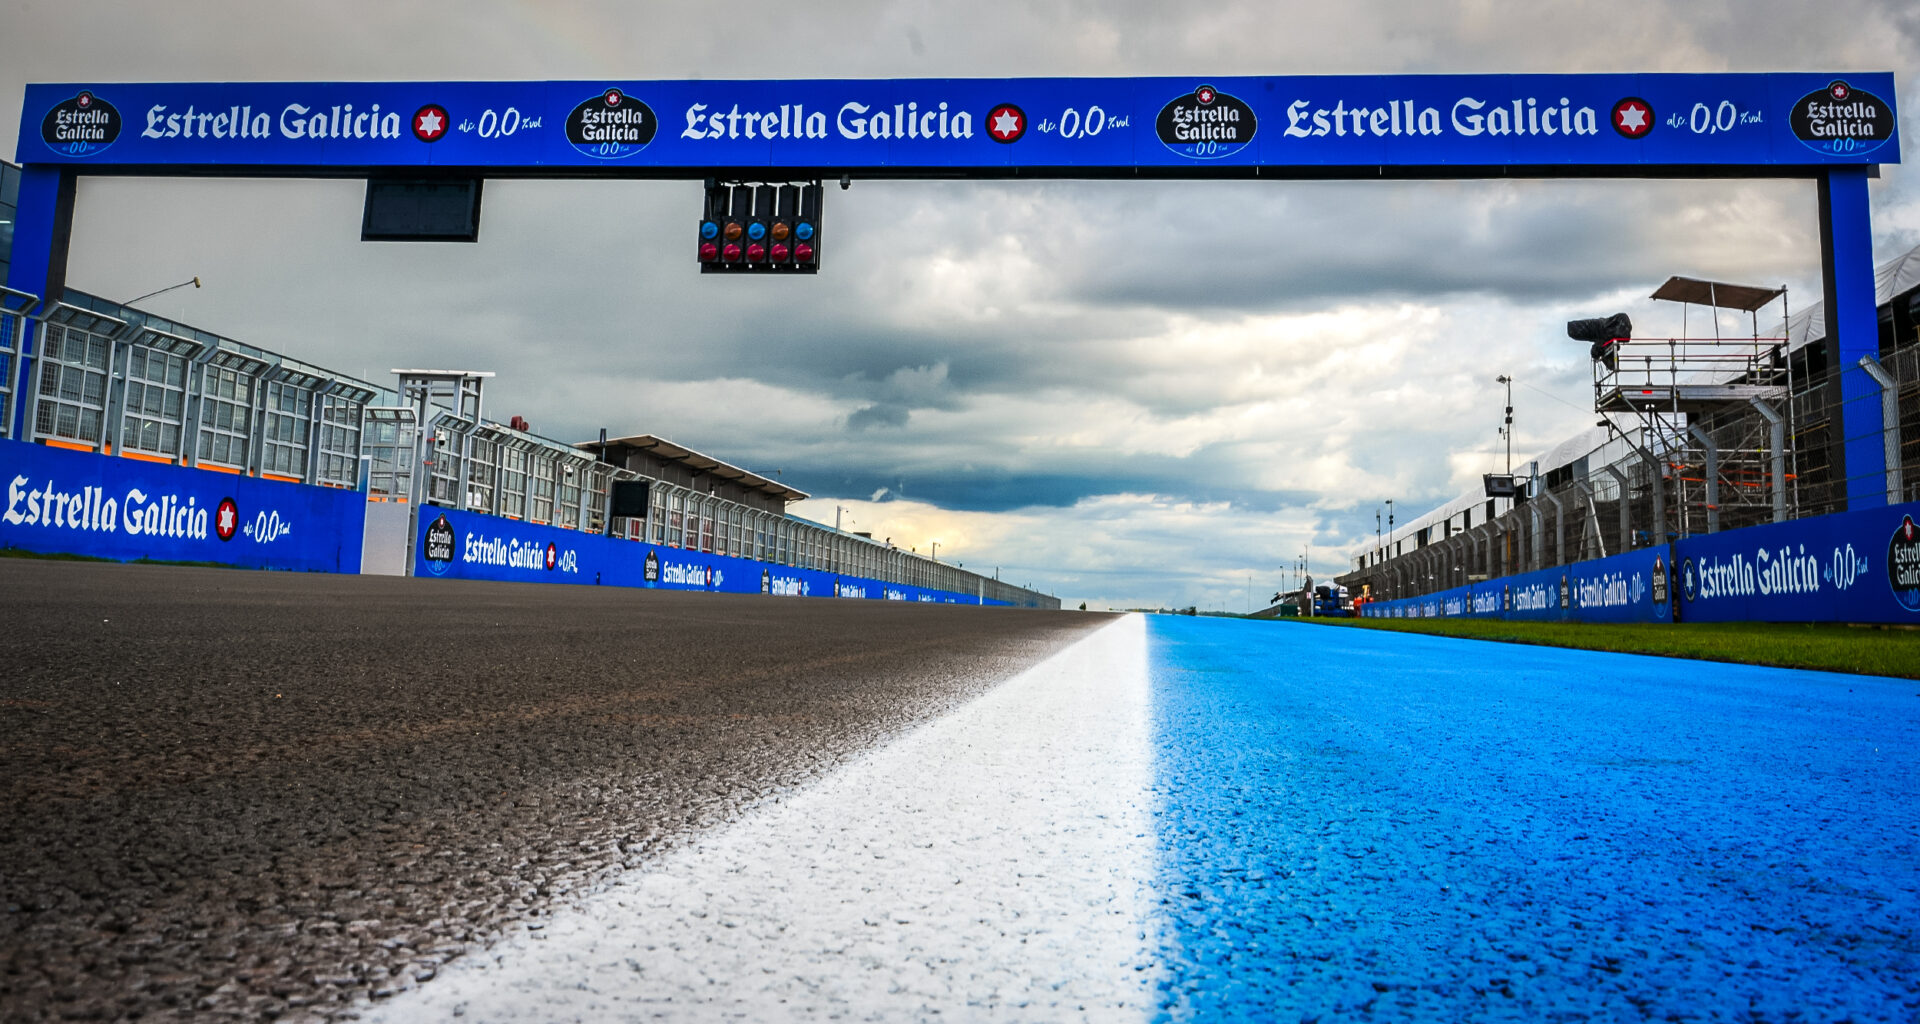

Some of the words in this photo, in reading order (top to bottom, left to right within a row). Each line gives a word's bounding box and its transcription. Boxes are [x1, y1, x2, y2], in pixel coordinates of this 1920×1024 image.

[55, 109, 109, 125] Estrella
[140, 104, 275, 138] Estrella
[279, 103, 401, 139] Galicia
[478, 106, 520, 139] 0,0
[580, 107, 643, 124] Estrella
[680, 102, 830, 140] Estrella
[835, 101, 974, 140] Galicia
[1059, 105, 1106, 139] 0,0
[1172, 105, 1240, 123] Estrella
[1283, 99, 1446, 138] Estrella
[1450, 97, 1599, 137] Galicia
[1690, 100, 1737, 135] 0,0
[1806, 101, 1877, 119] Estrella
[55, 124, 105, 140] Galicia
[582, 123, 639, 141] Galicia
[1175, 122, 1237, 141] Galicia
[1809, 118, 1875, 137] Galicia
[2, 474, 118, 533] Estrella
[123, 488, 208, 540] Galicia
[255, 510, 279, 544] 0,0
[429, 528, 452, 545] Estrella
[428, 543, 450, 559] Galicia
[463, 531, 507, 567] Estrella
[508, 537, 543, 570] Galicia
[1895, 542, 1920, 563] Estrell
[1698, 553, 1755, 599] Estrella
[1756, 543, 1820, 596] Galicia
[1833, 543, 1855, 591] 0,0
[1897, 563, 1920, 585] Galic
[1603, 571, 1627, 607] Galicia
